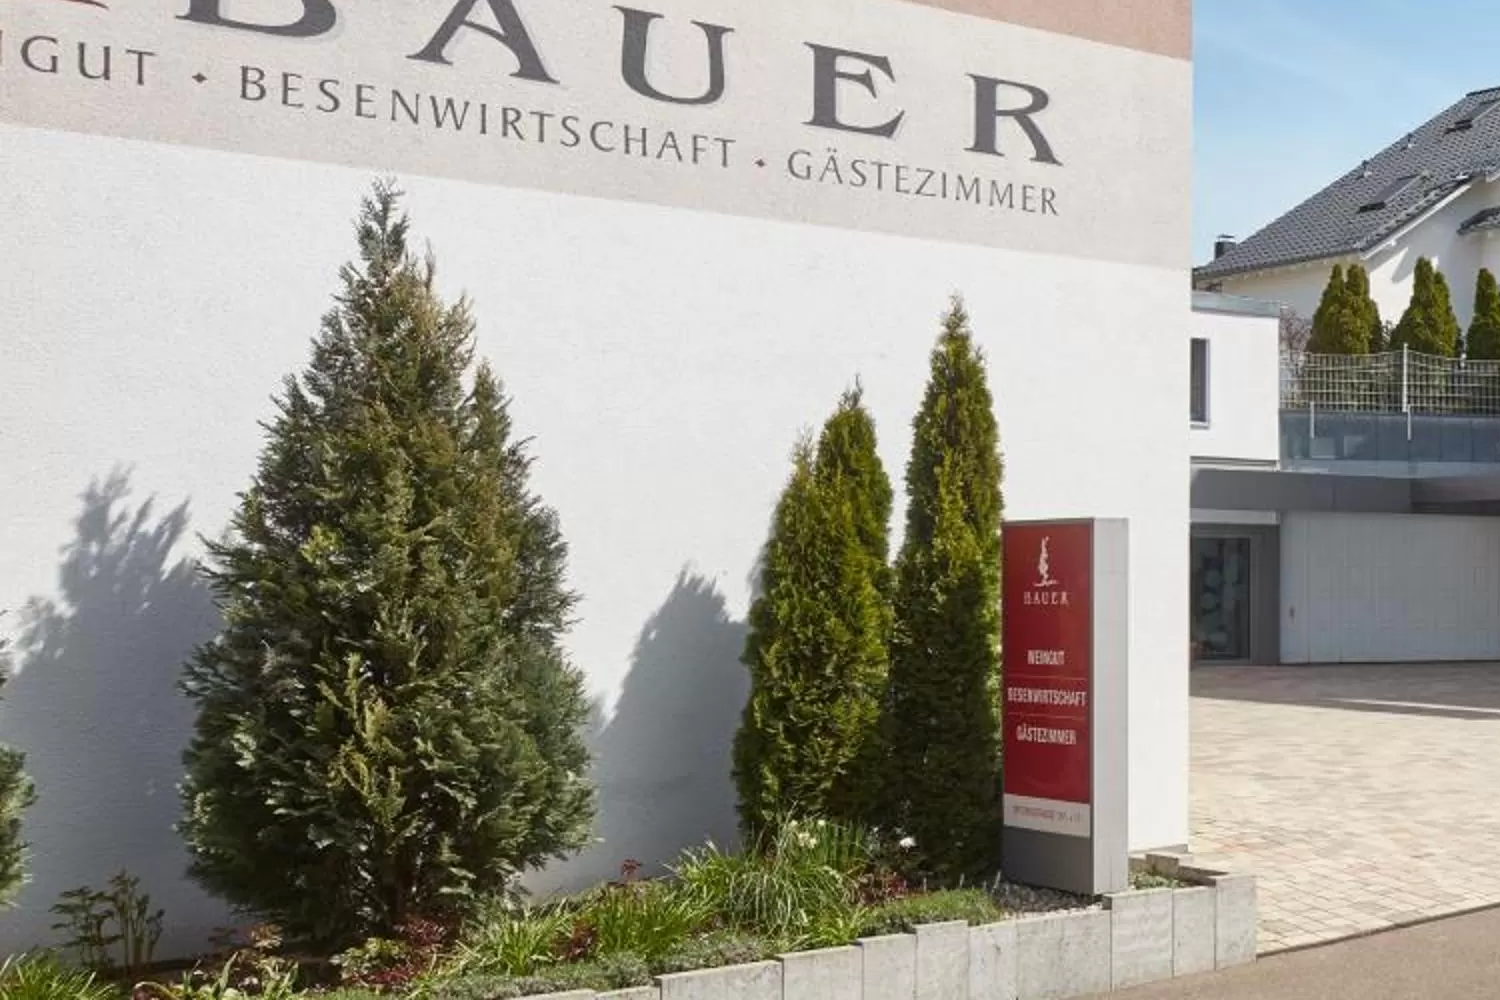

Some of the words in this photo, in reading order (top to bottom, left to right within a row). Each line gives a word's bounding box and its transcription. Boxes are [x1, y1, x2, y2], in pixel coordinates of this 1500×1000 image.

[0, 29, 157, 86] GUT
[239, 65, 736, 168] BESENWIRTSCHAFT
[787, 148, 1060, 216] GÄSTEZIMMER
[1027, 649, 1065, 665] WEINGUT
[1007, 687, 1086, 707] BESENWIRTSCHAFT
